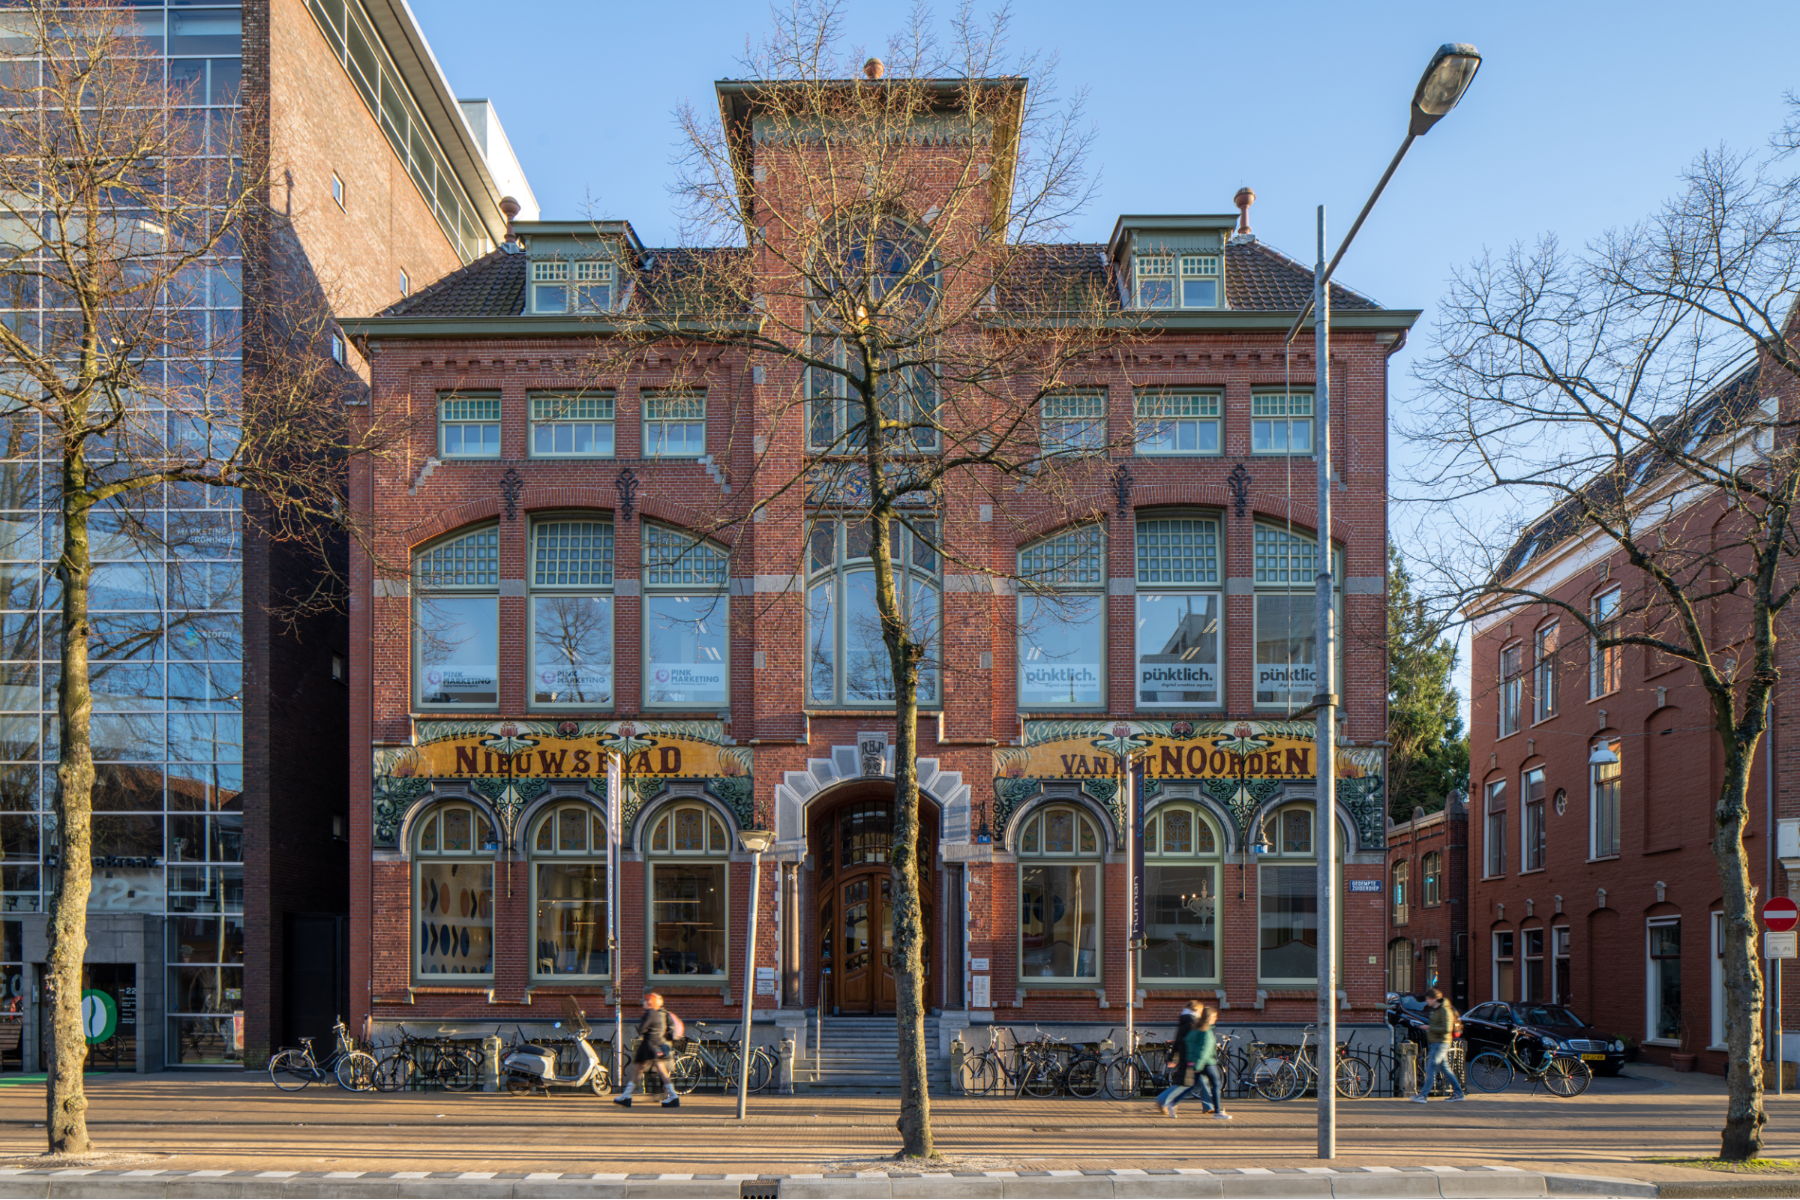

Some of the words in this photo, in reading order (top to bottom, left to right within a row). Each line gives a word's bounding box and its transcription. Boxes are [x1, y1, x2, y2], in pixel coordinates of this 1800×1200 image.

[177, 527, 227, 536] MARKETING
[189, 535, 239, 544] GRONINGEN
[556, 676, 606, 684] MARKETING
[671, 675, 719, 683] MARKETING
[1026, 667, 1096, 684] pünktlich.
[1142, 667, 1213, 684] pünktlich.
[1260, 668, 1317, 684] pünktlic
[443, 677, 491, 685] MARKETING
[1060, 754, 1109, 775] VAN
[1159, 745, 1311, 775] NOORDEN
